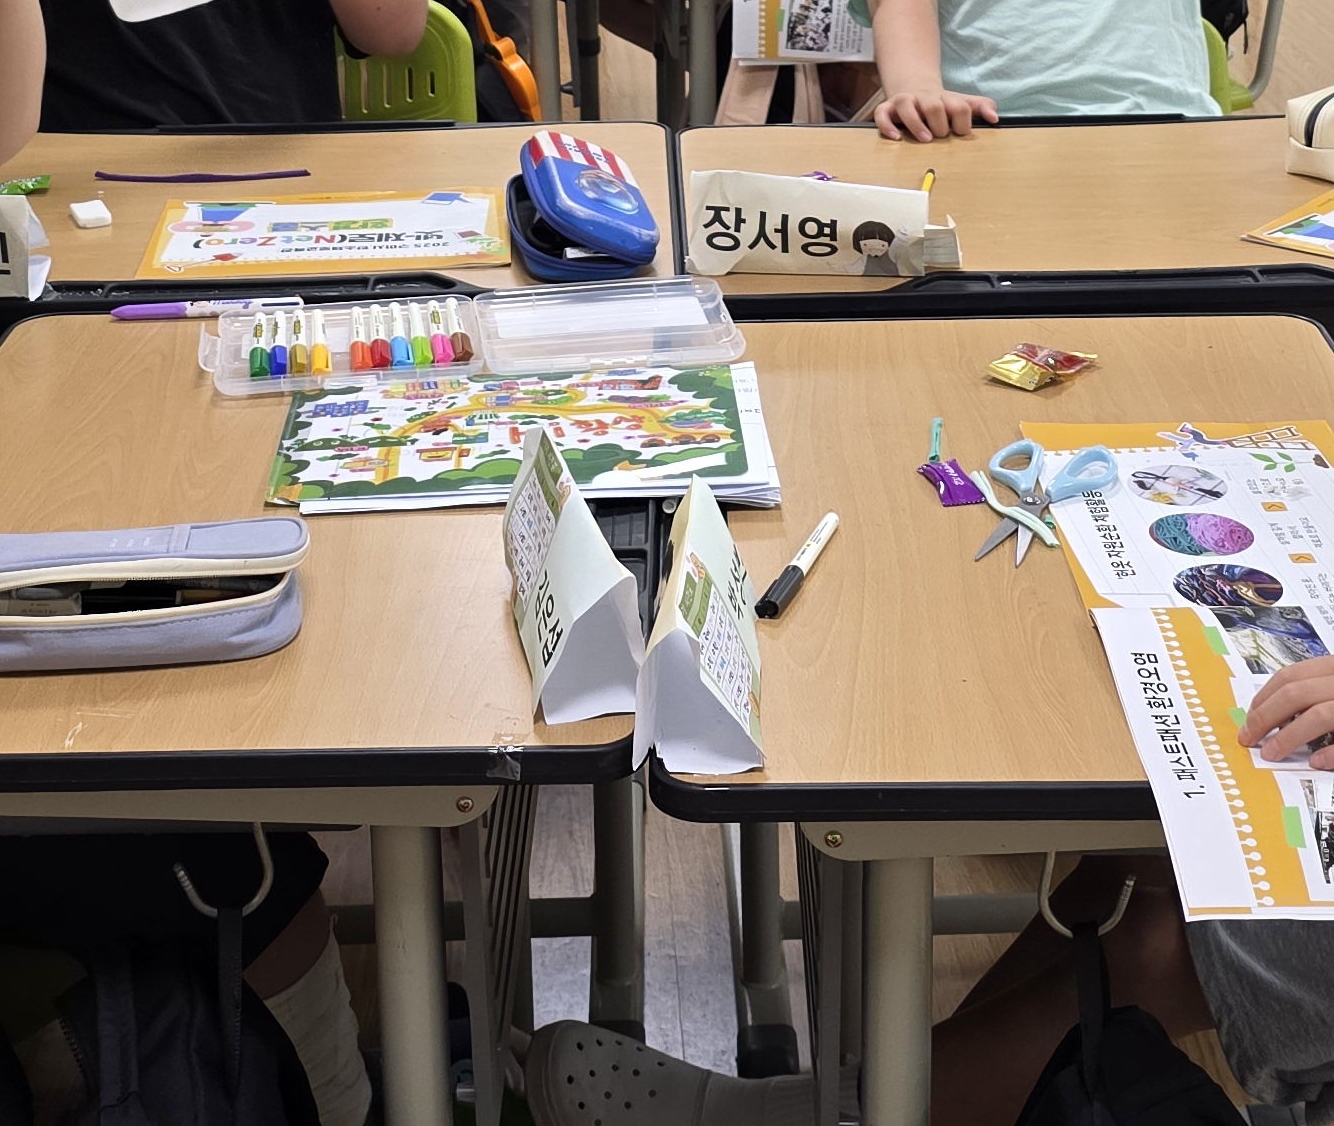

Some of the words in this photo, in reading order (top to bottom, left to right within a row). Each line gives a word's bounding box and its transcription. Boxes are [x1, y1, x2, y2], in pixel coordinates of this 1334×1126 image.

[414, 241, 449, 249] 2025
[702, 205, 839, 257] 장서영
[1130, 652, 1175, 710] 환경오염
[1150, 714, 1199, 781] 패스트패션
[1183, 785, 1206, 800] 1.
